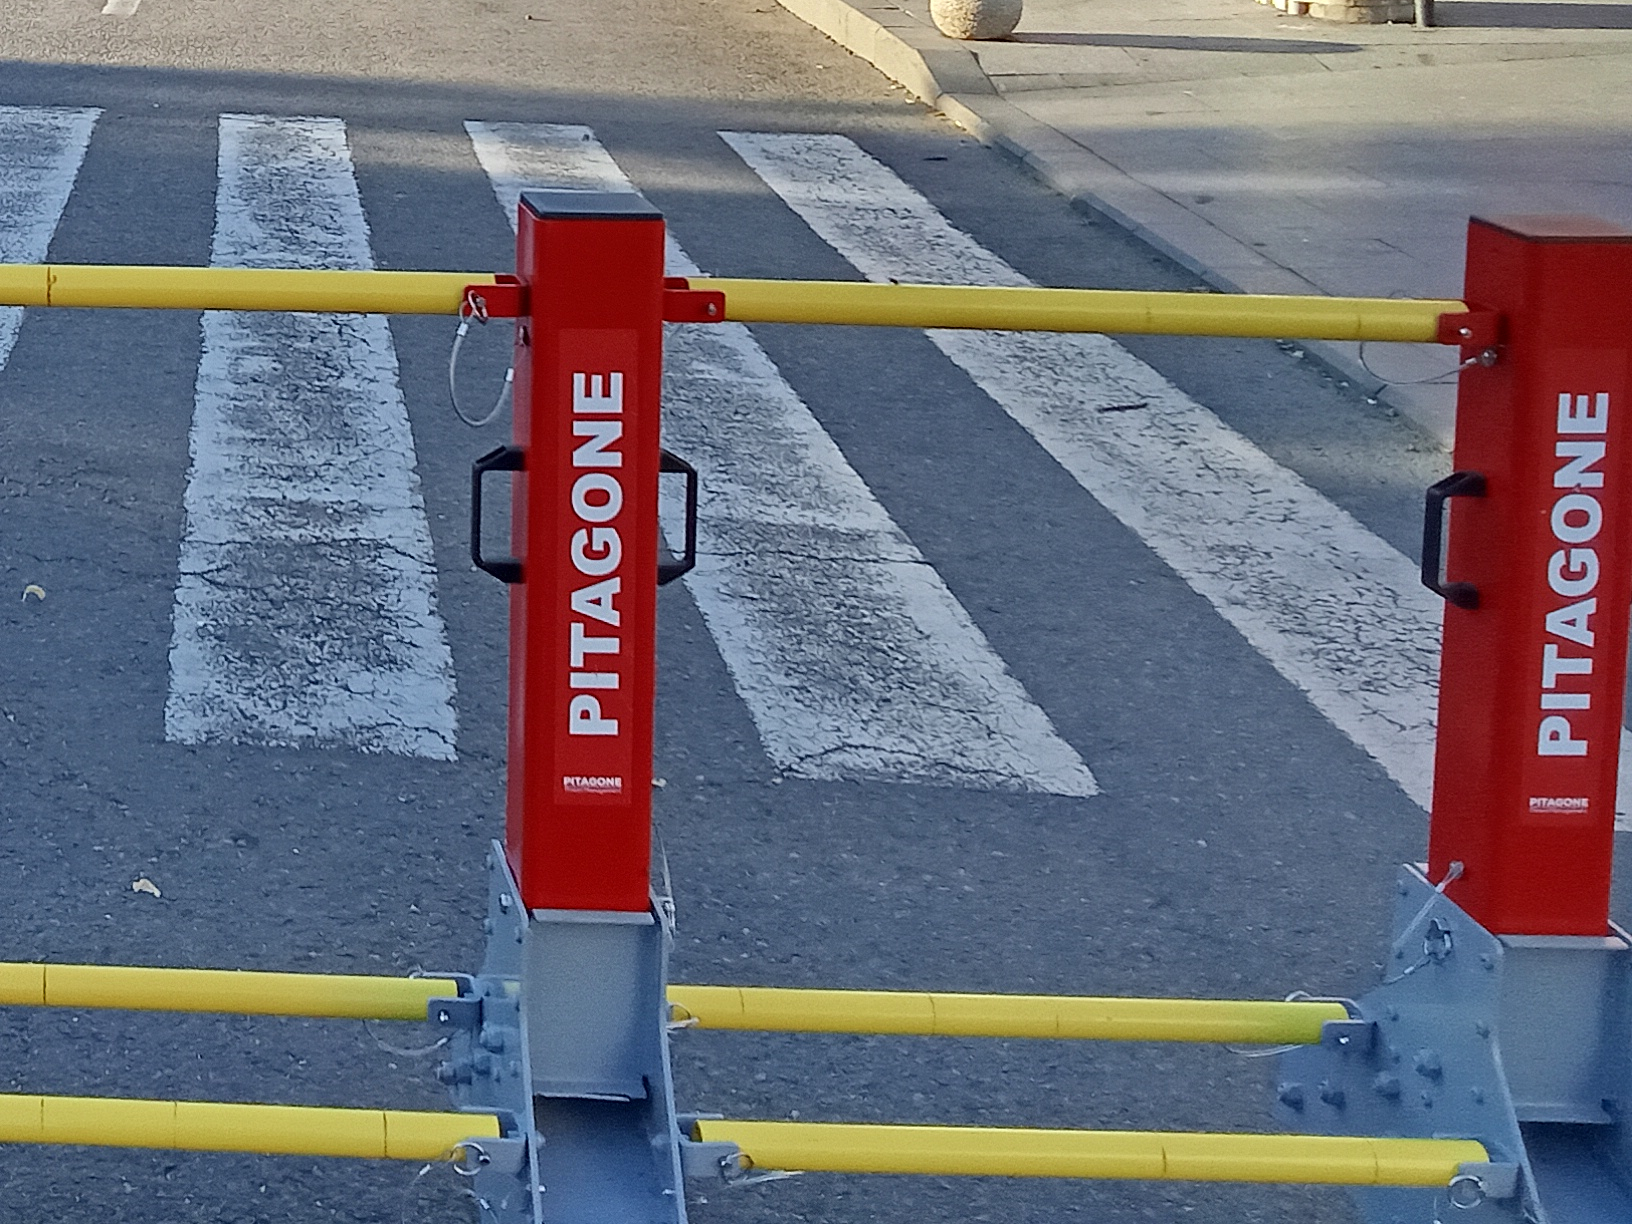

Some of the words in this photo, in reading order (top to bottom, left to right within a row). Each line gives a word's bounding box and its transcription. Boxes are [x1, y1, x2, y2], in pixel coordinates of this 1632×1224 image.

[569, 372, 624, 736] PITAGONE
[1537, 392, 1609, 756] PITAGONE
[563, 776, 621, 787] PITAGONE
[1529, 797, 1588, 807] PITAGONE
